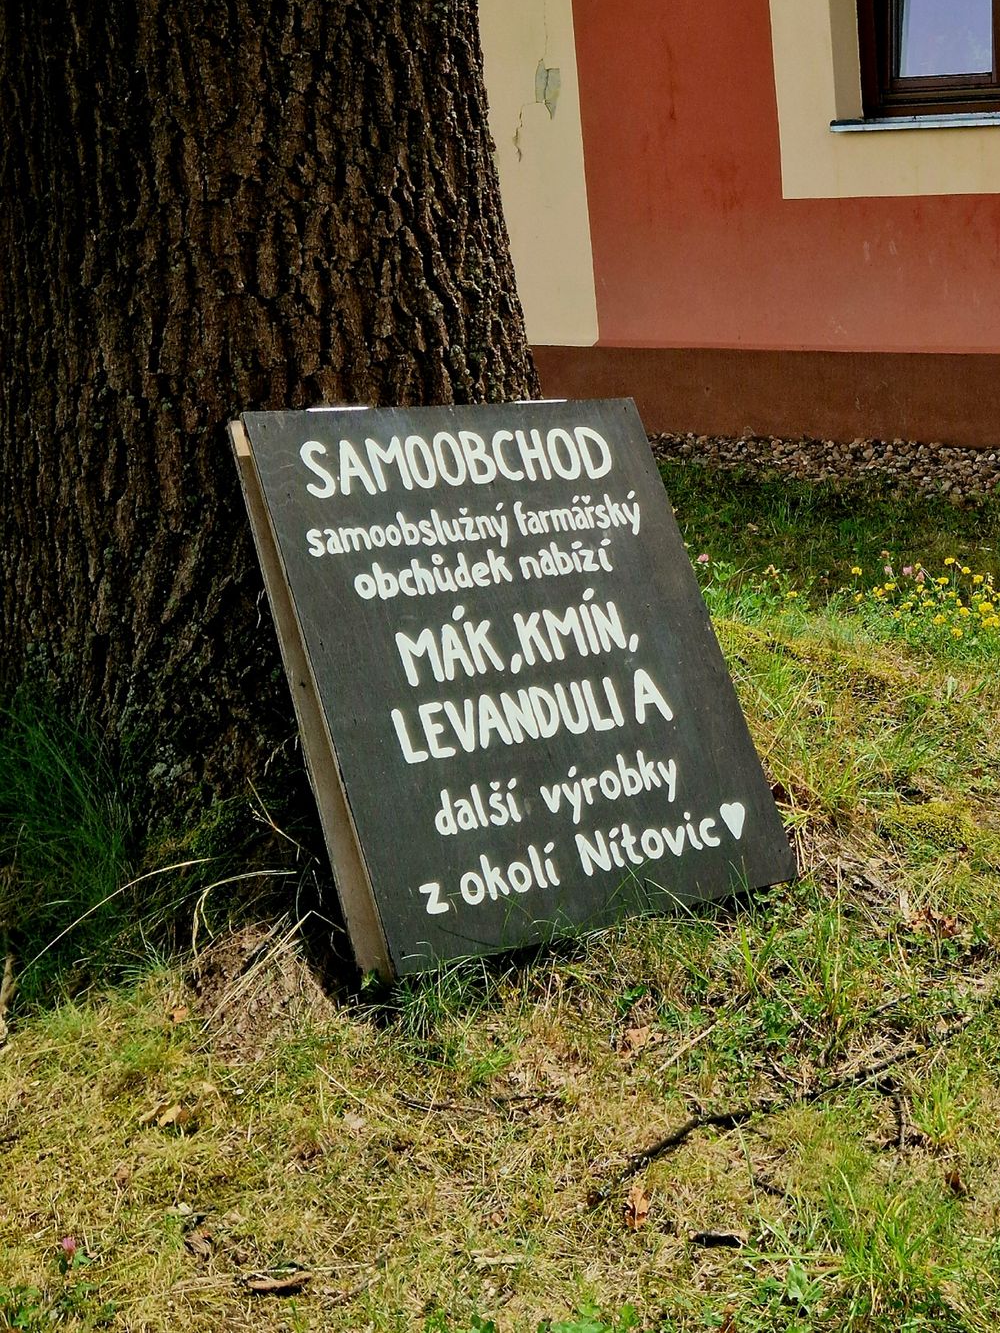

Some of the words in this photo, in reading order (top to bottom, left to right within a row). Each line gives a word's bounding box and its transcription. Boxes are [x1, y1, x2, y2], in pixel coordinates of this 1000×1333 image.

[299, 426, 613, 499] SAMOOBCHOD
[305, 502, 509, 558] samoobslužný
[513, 490, 641, 537] farmářský
[353, 548, 513, 601] obchůdek
[518, 537, 614, 580] nabízí
[390, 676, 625, 764] LEVANDULI
[633, 668, 674, 725] A
[434, 777, 522, 836] další
[539, 749, 677, 825] výrobky
[418, 881, 450, 915] z
[459, 841, 561, 906] okolí
[574, 811, 721, 877] Nítovic
